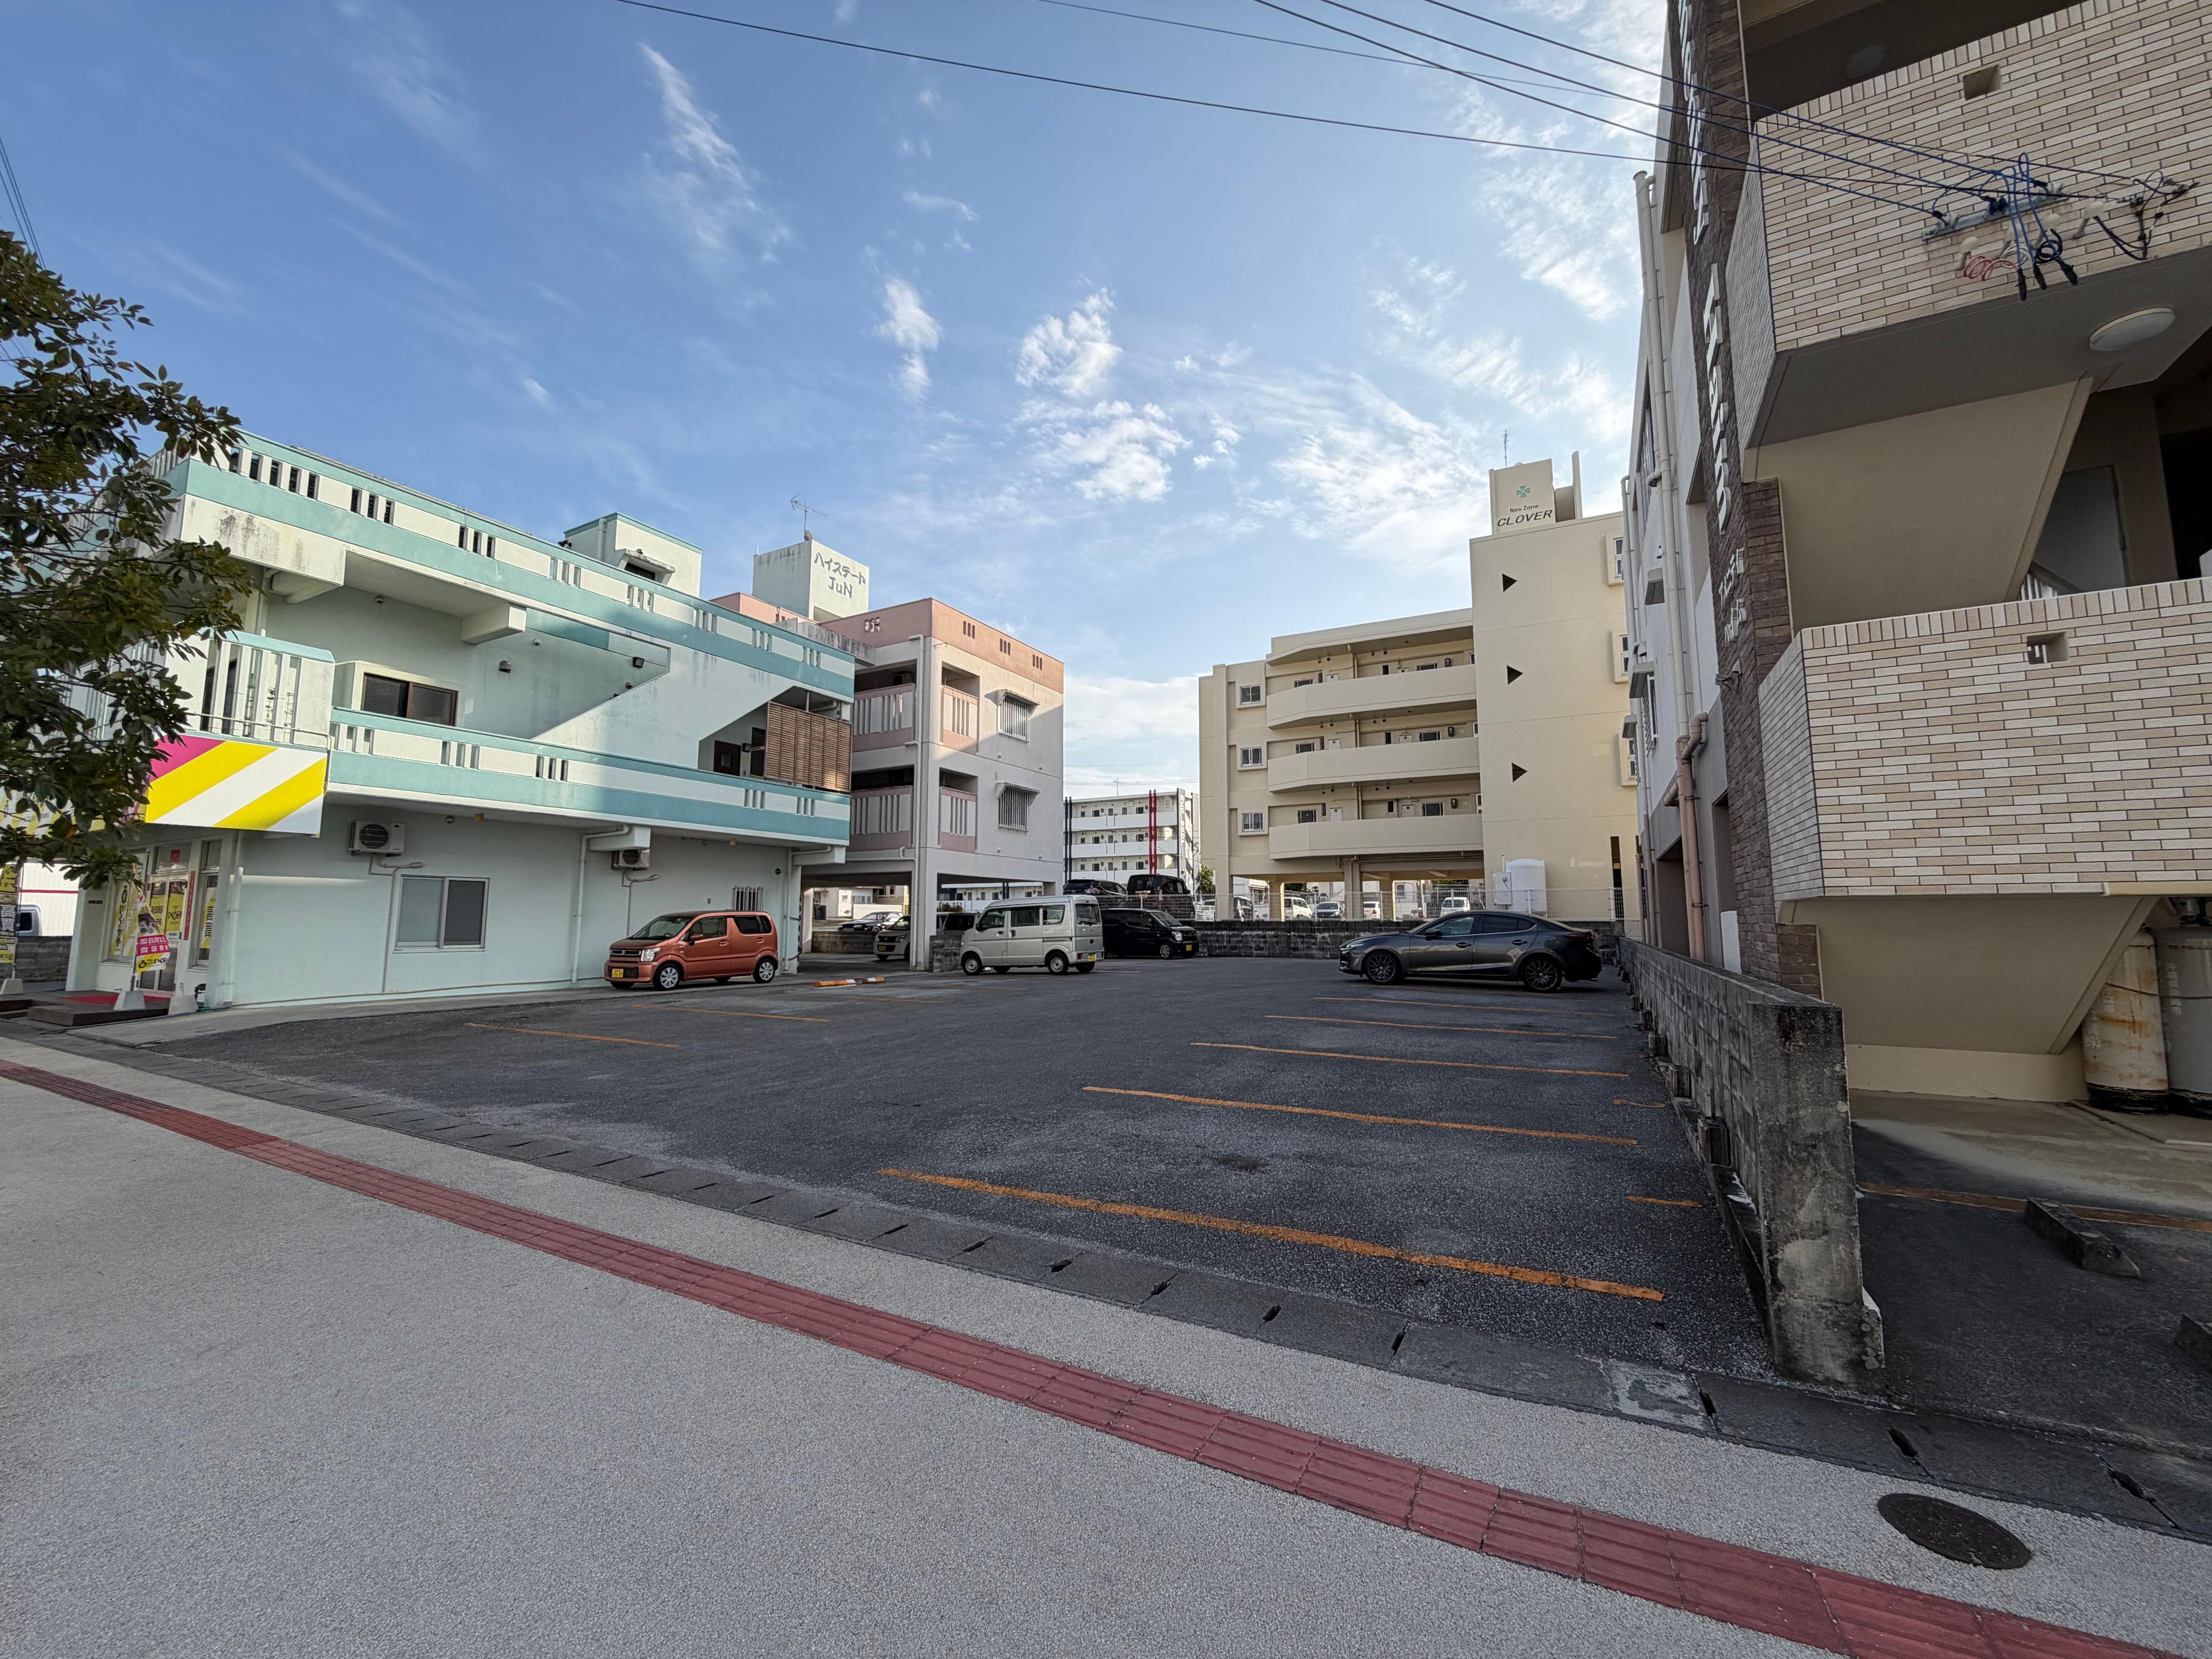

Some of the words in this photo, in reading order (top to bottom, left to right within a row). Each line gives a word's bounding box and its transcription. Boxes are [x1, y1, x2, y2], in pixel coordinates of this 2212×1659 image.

[1703, 273, 1729, 535] Haim
[1497, 509, 1553, 527] CLOVER
[814, 552, 866, 585] ハイステート
